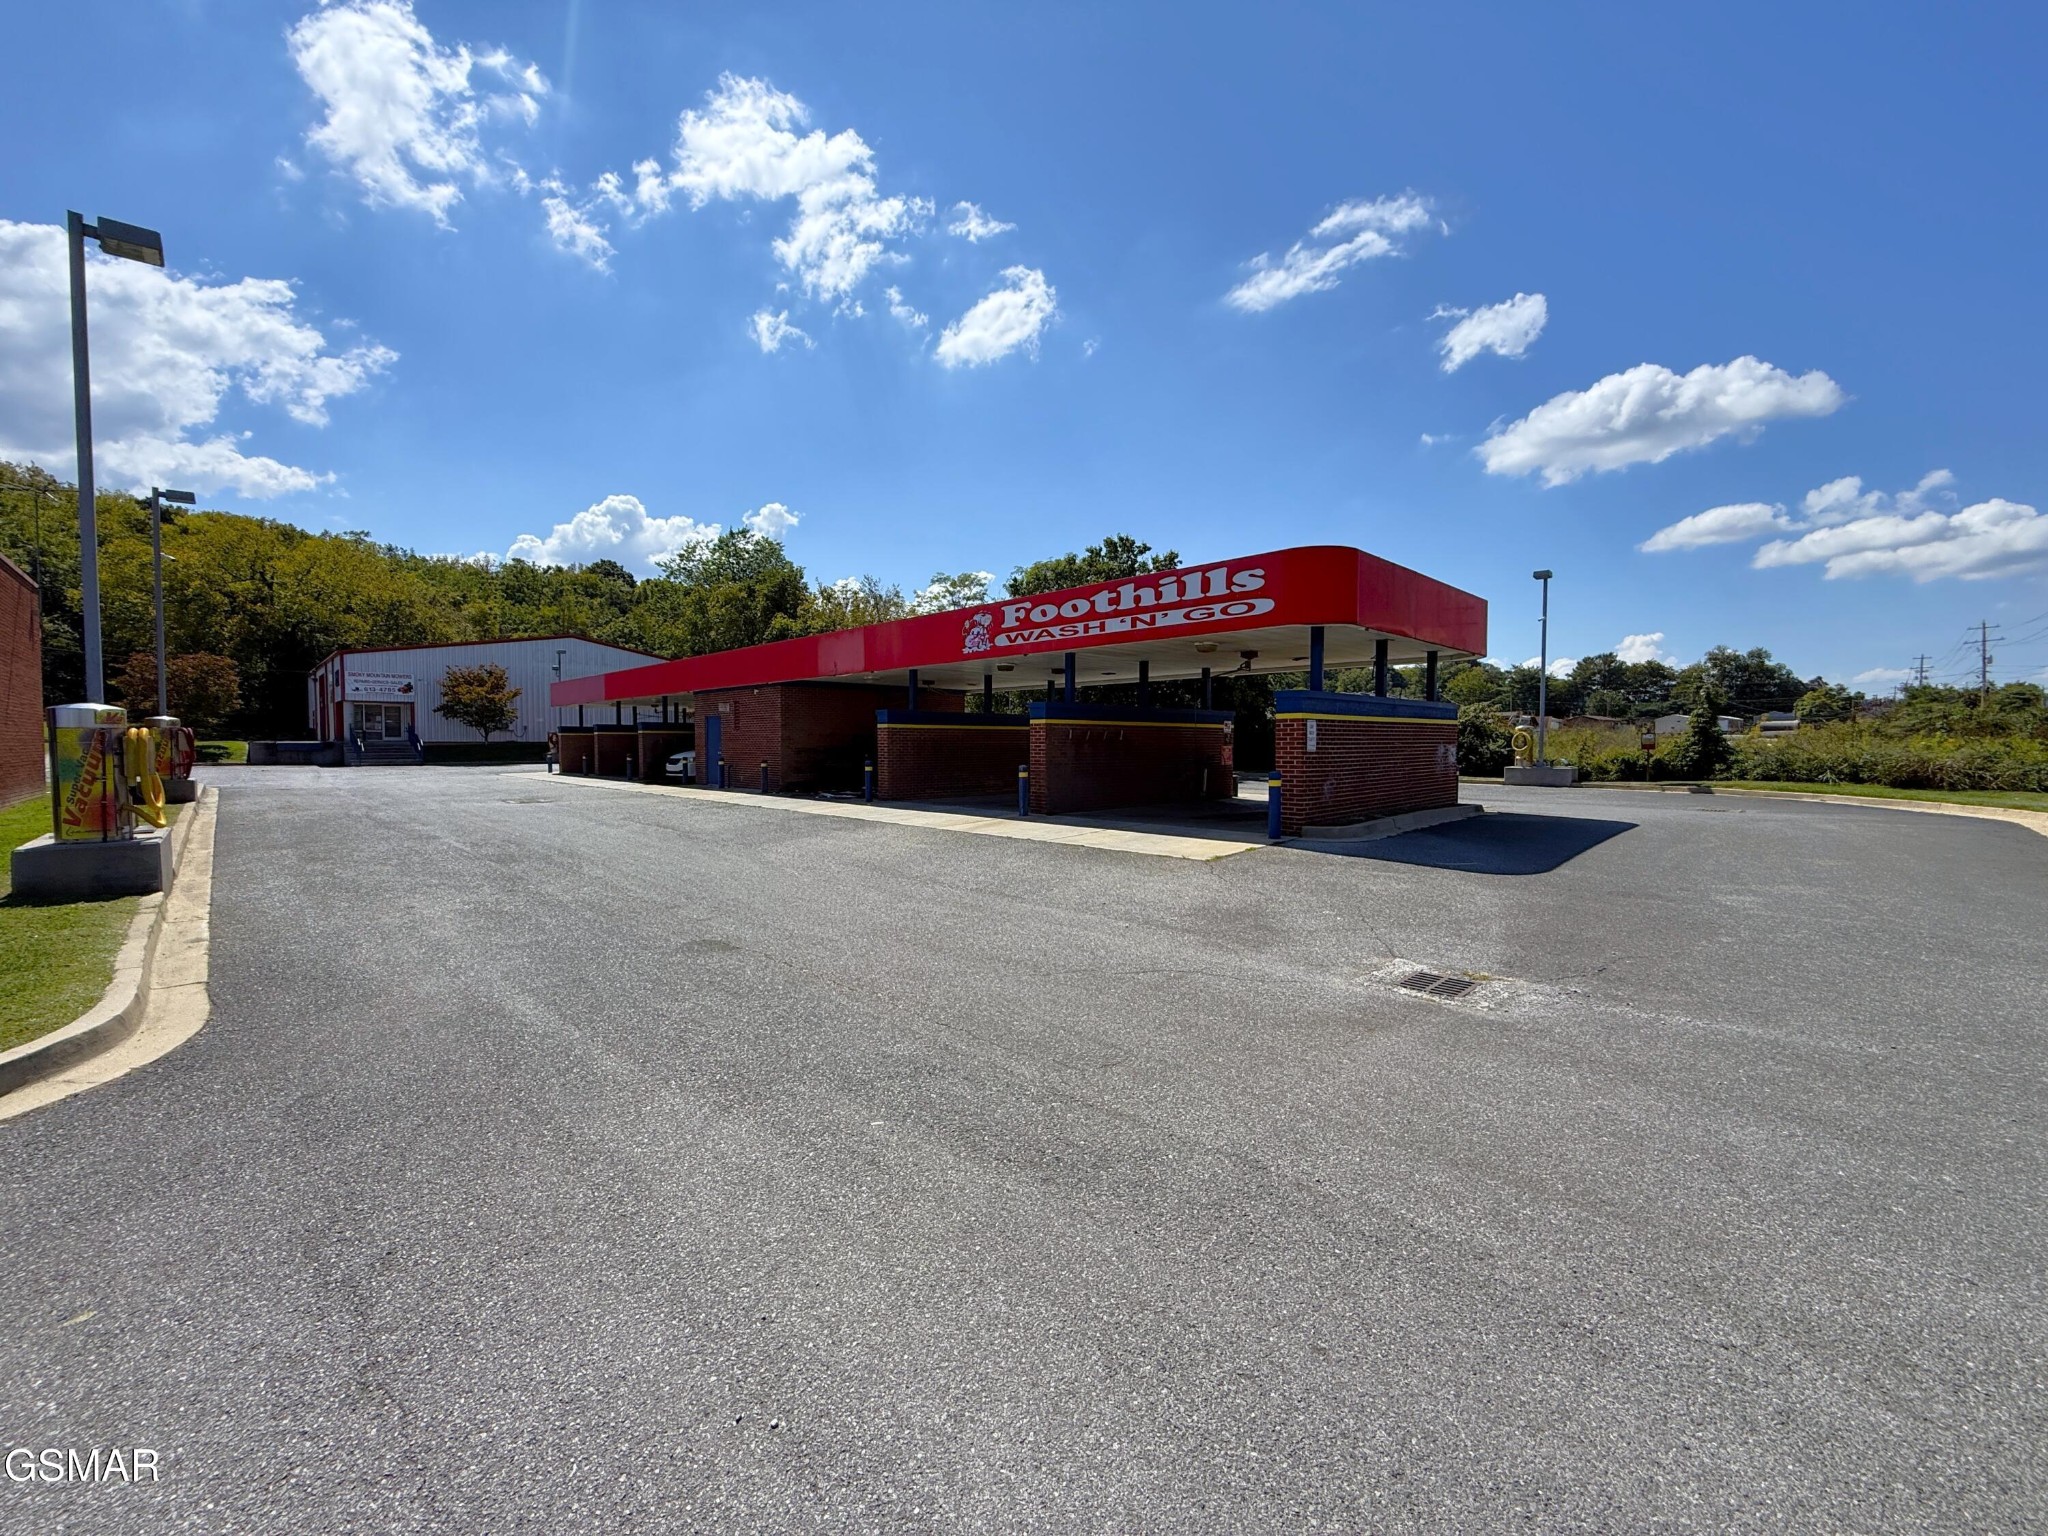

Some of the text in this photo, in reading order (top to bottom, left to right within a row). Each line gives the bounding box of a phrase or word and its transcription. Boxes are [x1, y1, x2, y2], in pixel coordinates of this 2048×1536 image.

[1001, 567, 1265, 628] Foothills
[1005, 620, 1106, 644] WASH
[1183, 601, 1256, 622] GO
[67, 748, 89, 805] Super Vac
